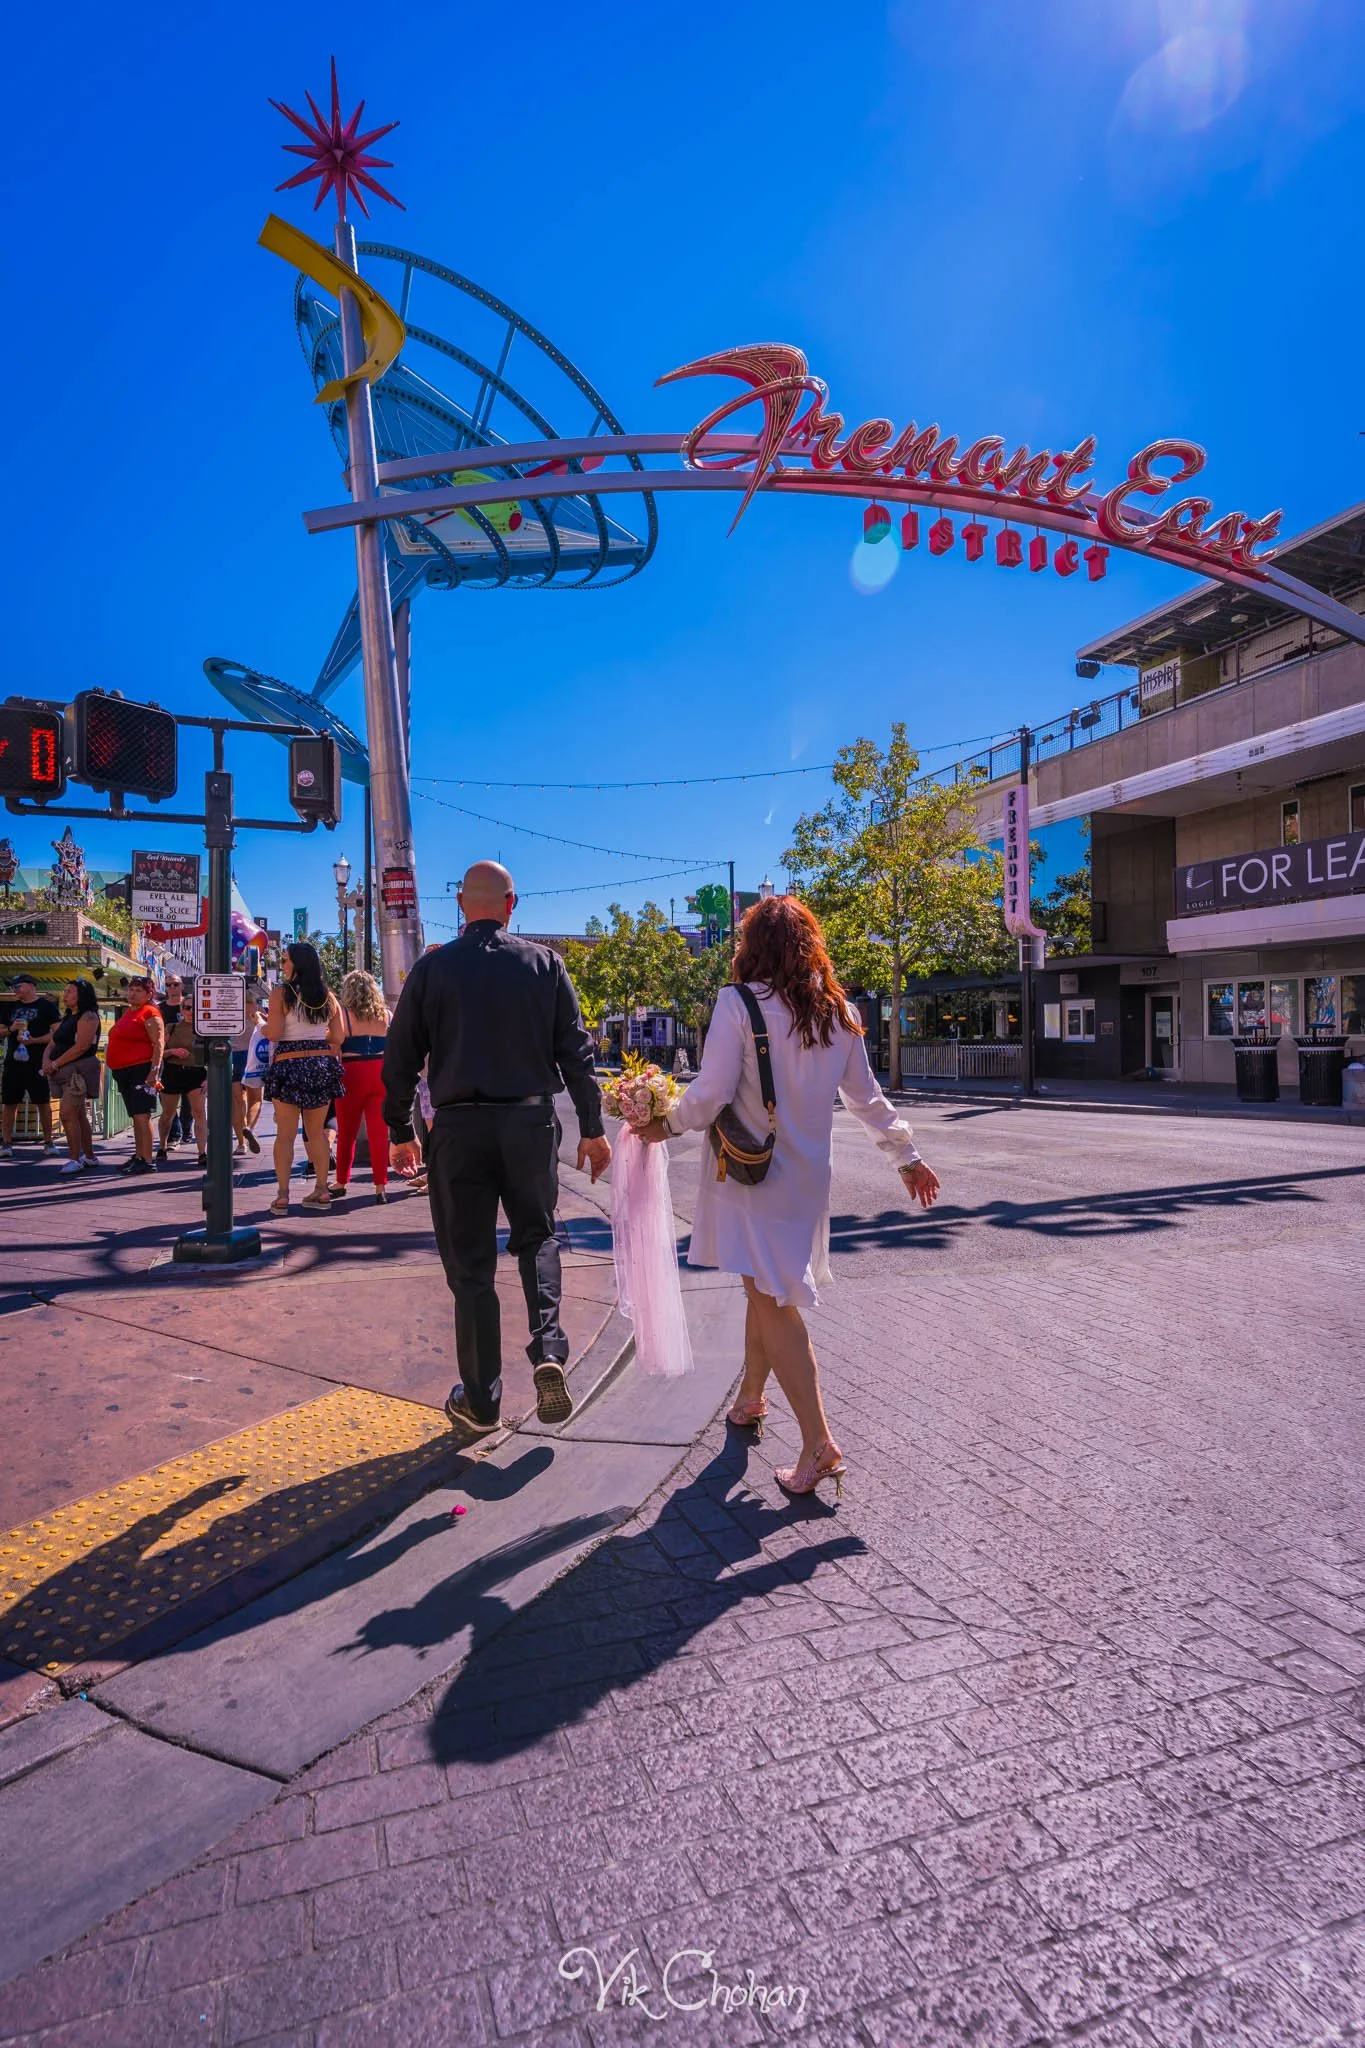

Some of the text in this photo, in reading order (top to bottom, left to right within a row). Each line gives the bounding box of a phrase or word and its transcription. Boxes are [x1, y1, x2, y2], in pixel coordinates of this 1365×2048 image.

[653, 342, 1284, 570] Fremont East
[863, 502, 1110, 582] DISTRICT
[1007, 790, 1019, 914] FREMONT
[1221, 853, 1293, 897] FOR
[149, 892, 167, 900] EVEL
[1186, 899, 1215, 910] LOGIC
[139, 905, 190, 915] CHEESE SLICE
[1141, 966, 1158, 977] 107
